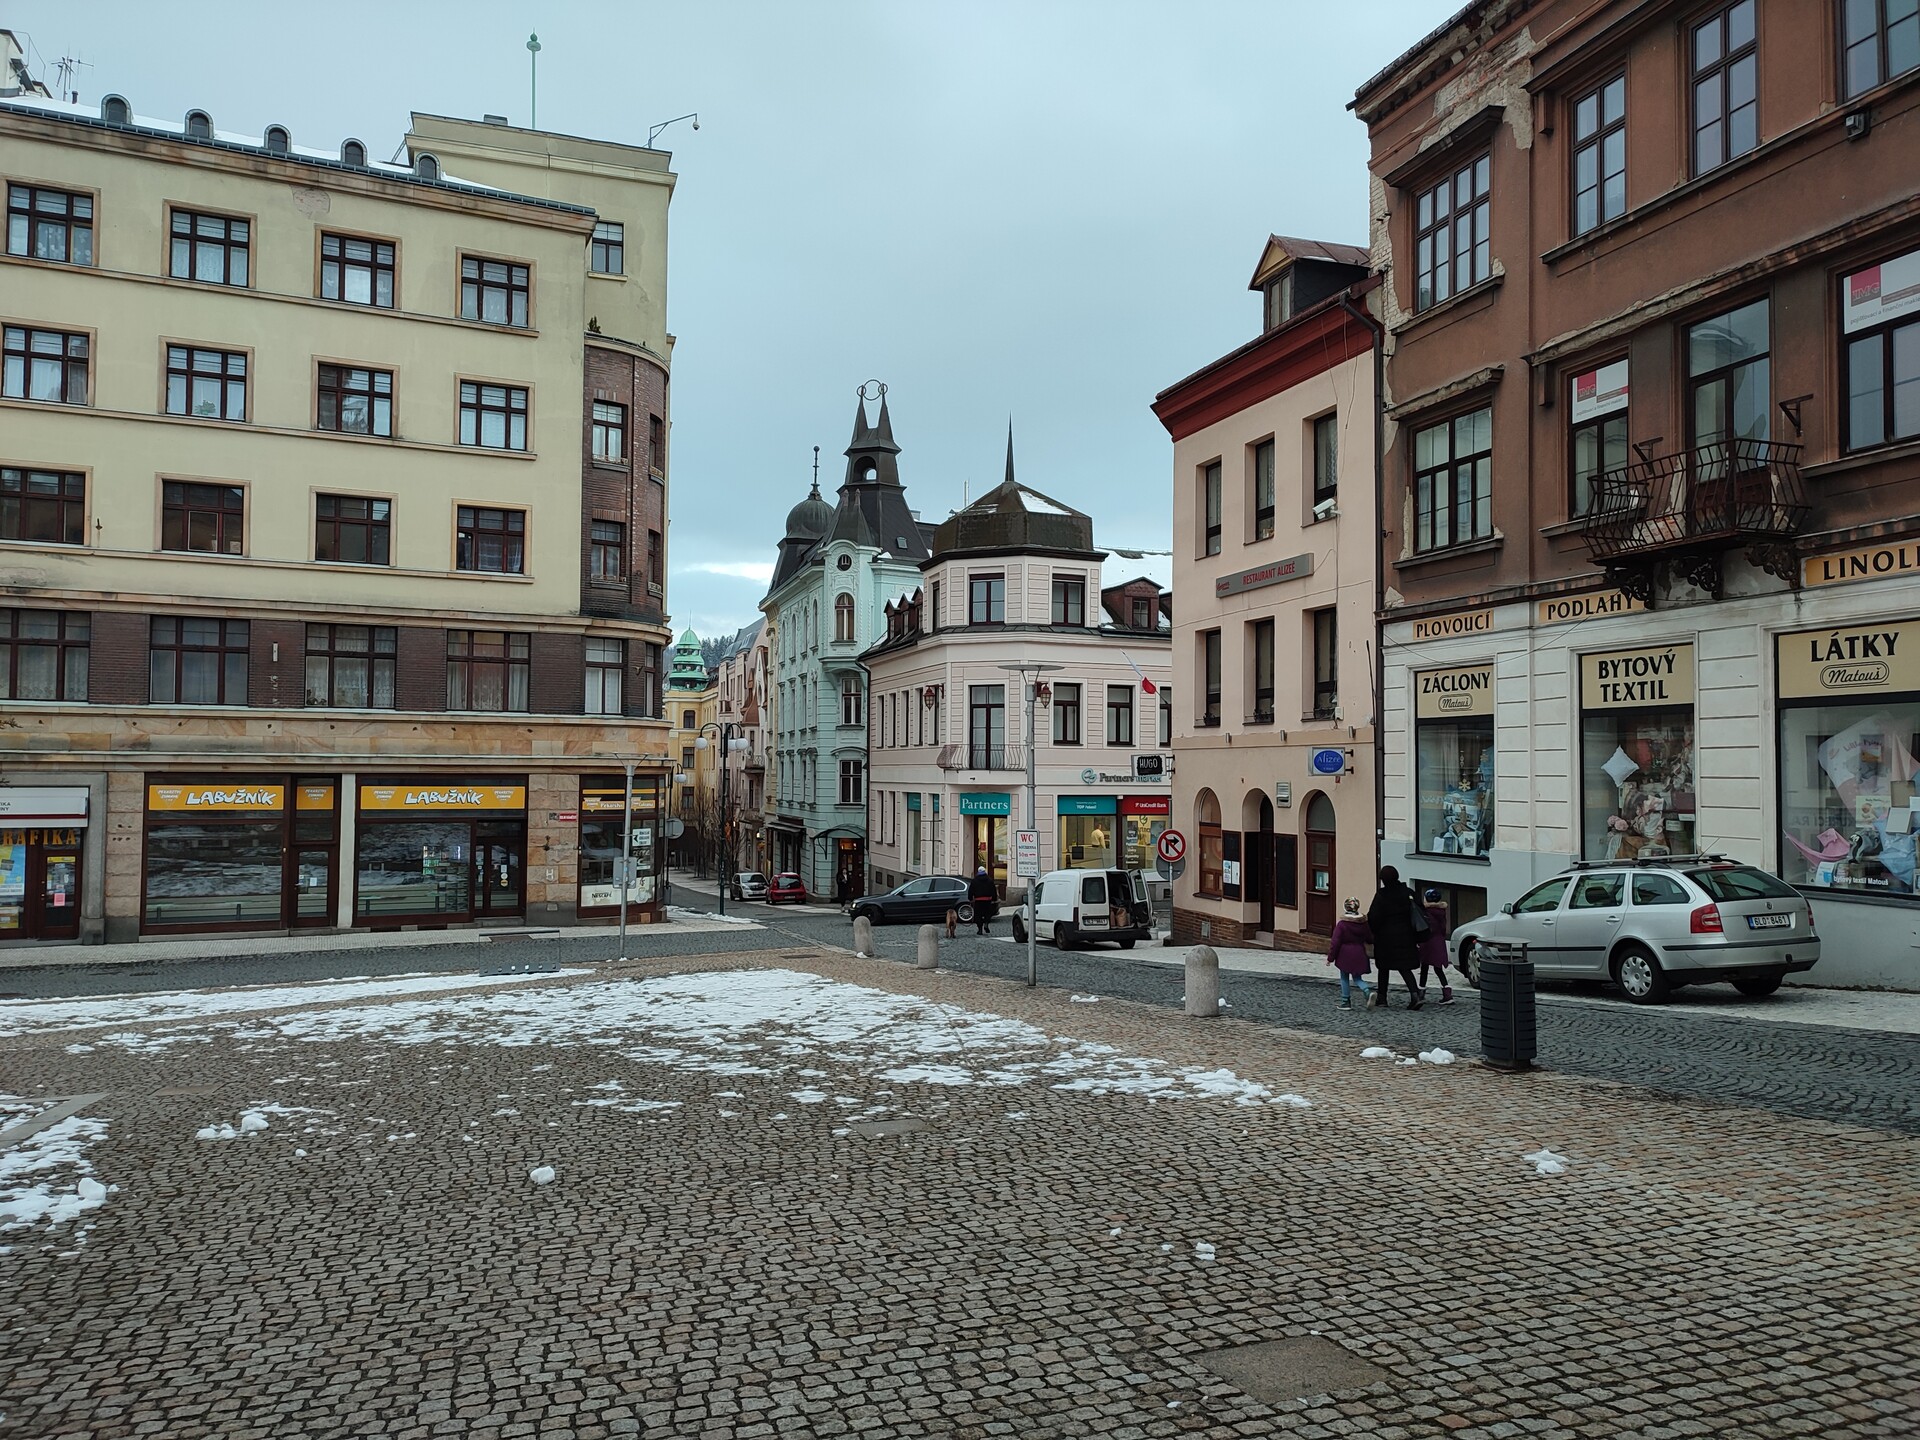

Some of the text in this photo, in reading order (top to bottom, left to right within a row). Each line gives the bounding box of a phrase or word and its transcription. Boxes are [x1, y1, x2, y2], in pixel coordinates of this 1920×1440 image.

[1242, 567, 1276, 585] RESTAURANT
[1416, 593, 1633, 638] PLOVOUCÍ PODLAHY
[1811, 631, 1900, 662] LÁTKY
[1598, 648, 1677, 679] BYTOVÝ
[1422, 671, 1491, 694] ZÁCLONY
[1828, 667, 1884, 684] Matouš
[1600, 679, 1669, 703] TEXTIL
[1139, 758, 1158, 768] HUGO
[1099, 772, 1134, 783] Partners
[961, 798, 1009, 810] Partners
[1020, 833, 1034, 843] WC
